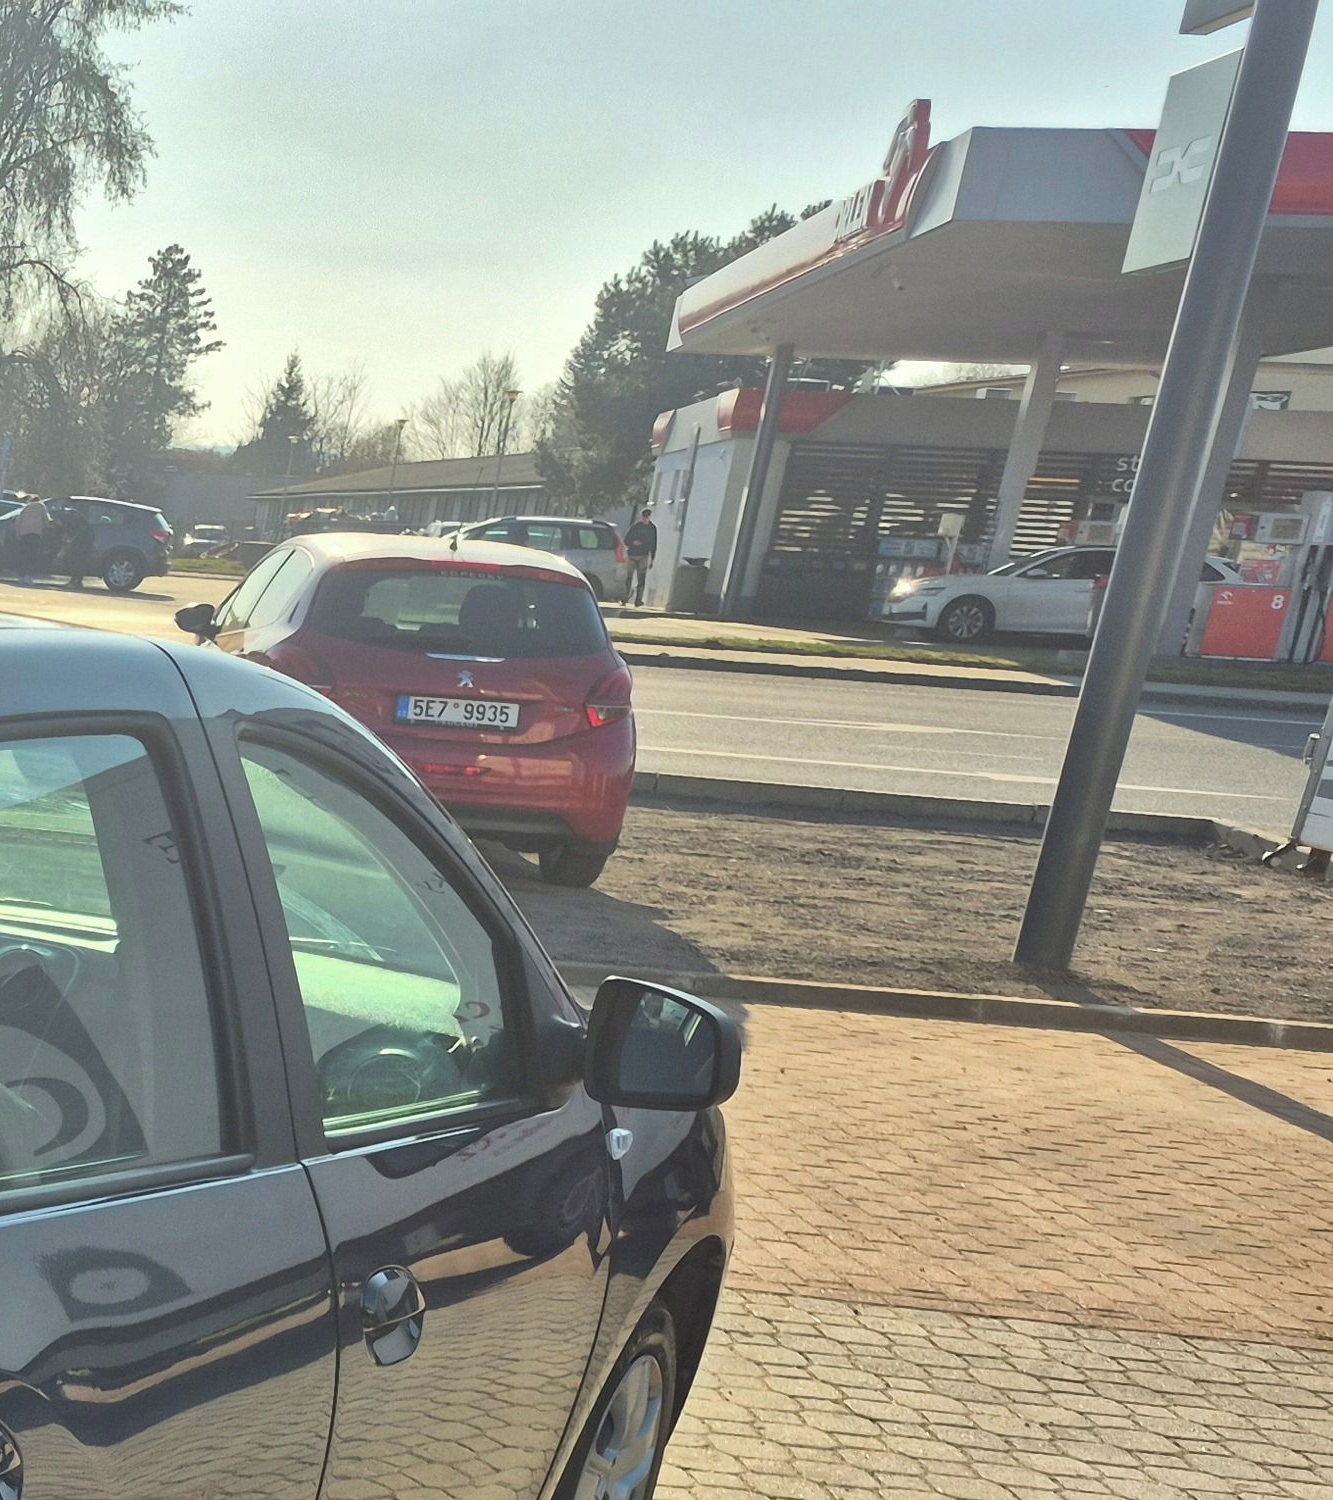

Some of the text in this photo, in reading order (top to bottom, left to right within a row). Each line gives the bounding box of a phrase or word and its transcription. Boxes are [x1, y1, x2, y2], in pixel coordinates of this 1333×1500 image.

[1271, 594, 1285, 610] 8
[413, 699, 449, 719] 5E7
[463, 702, 511, 724] 9935
